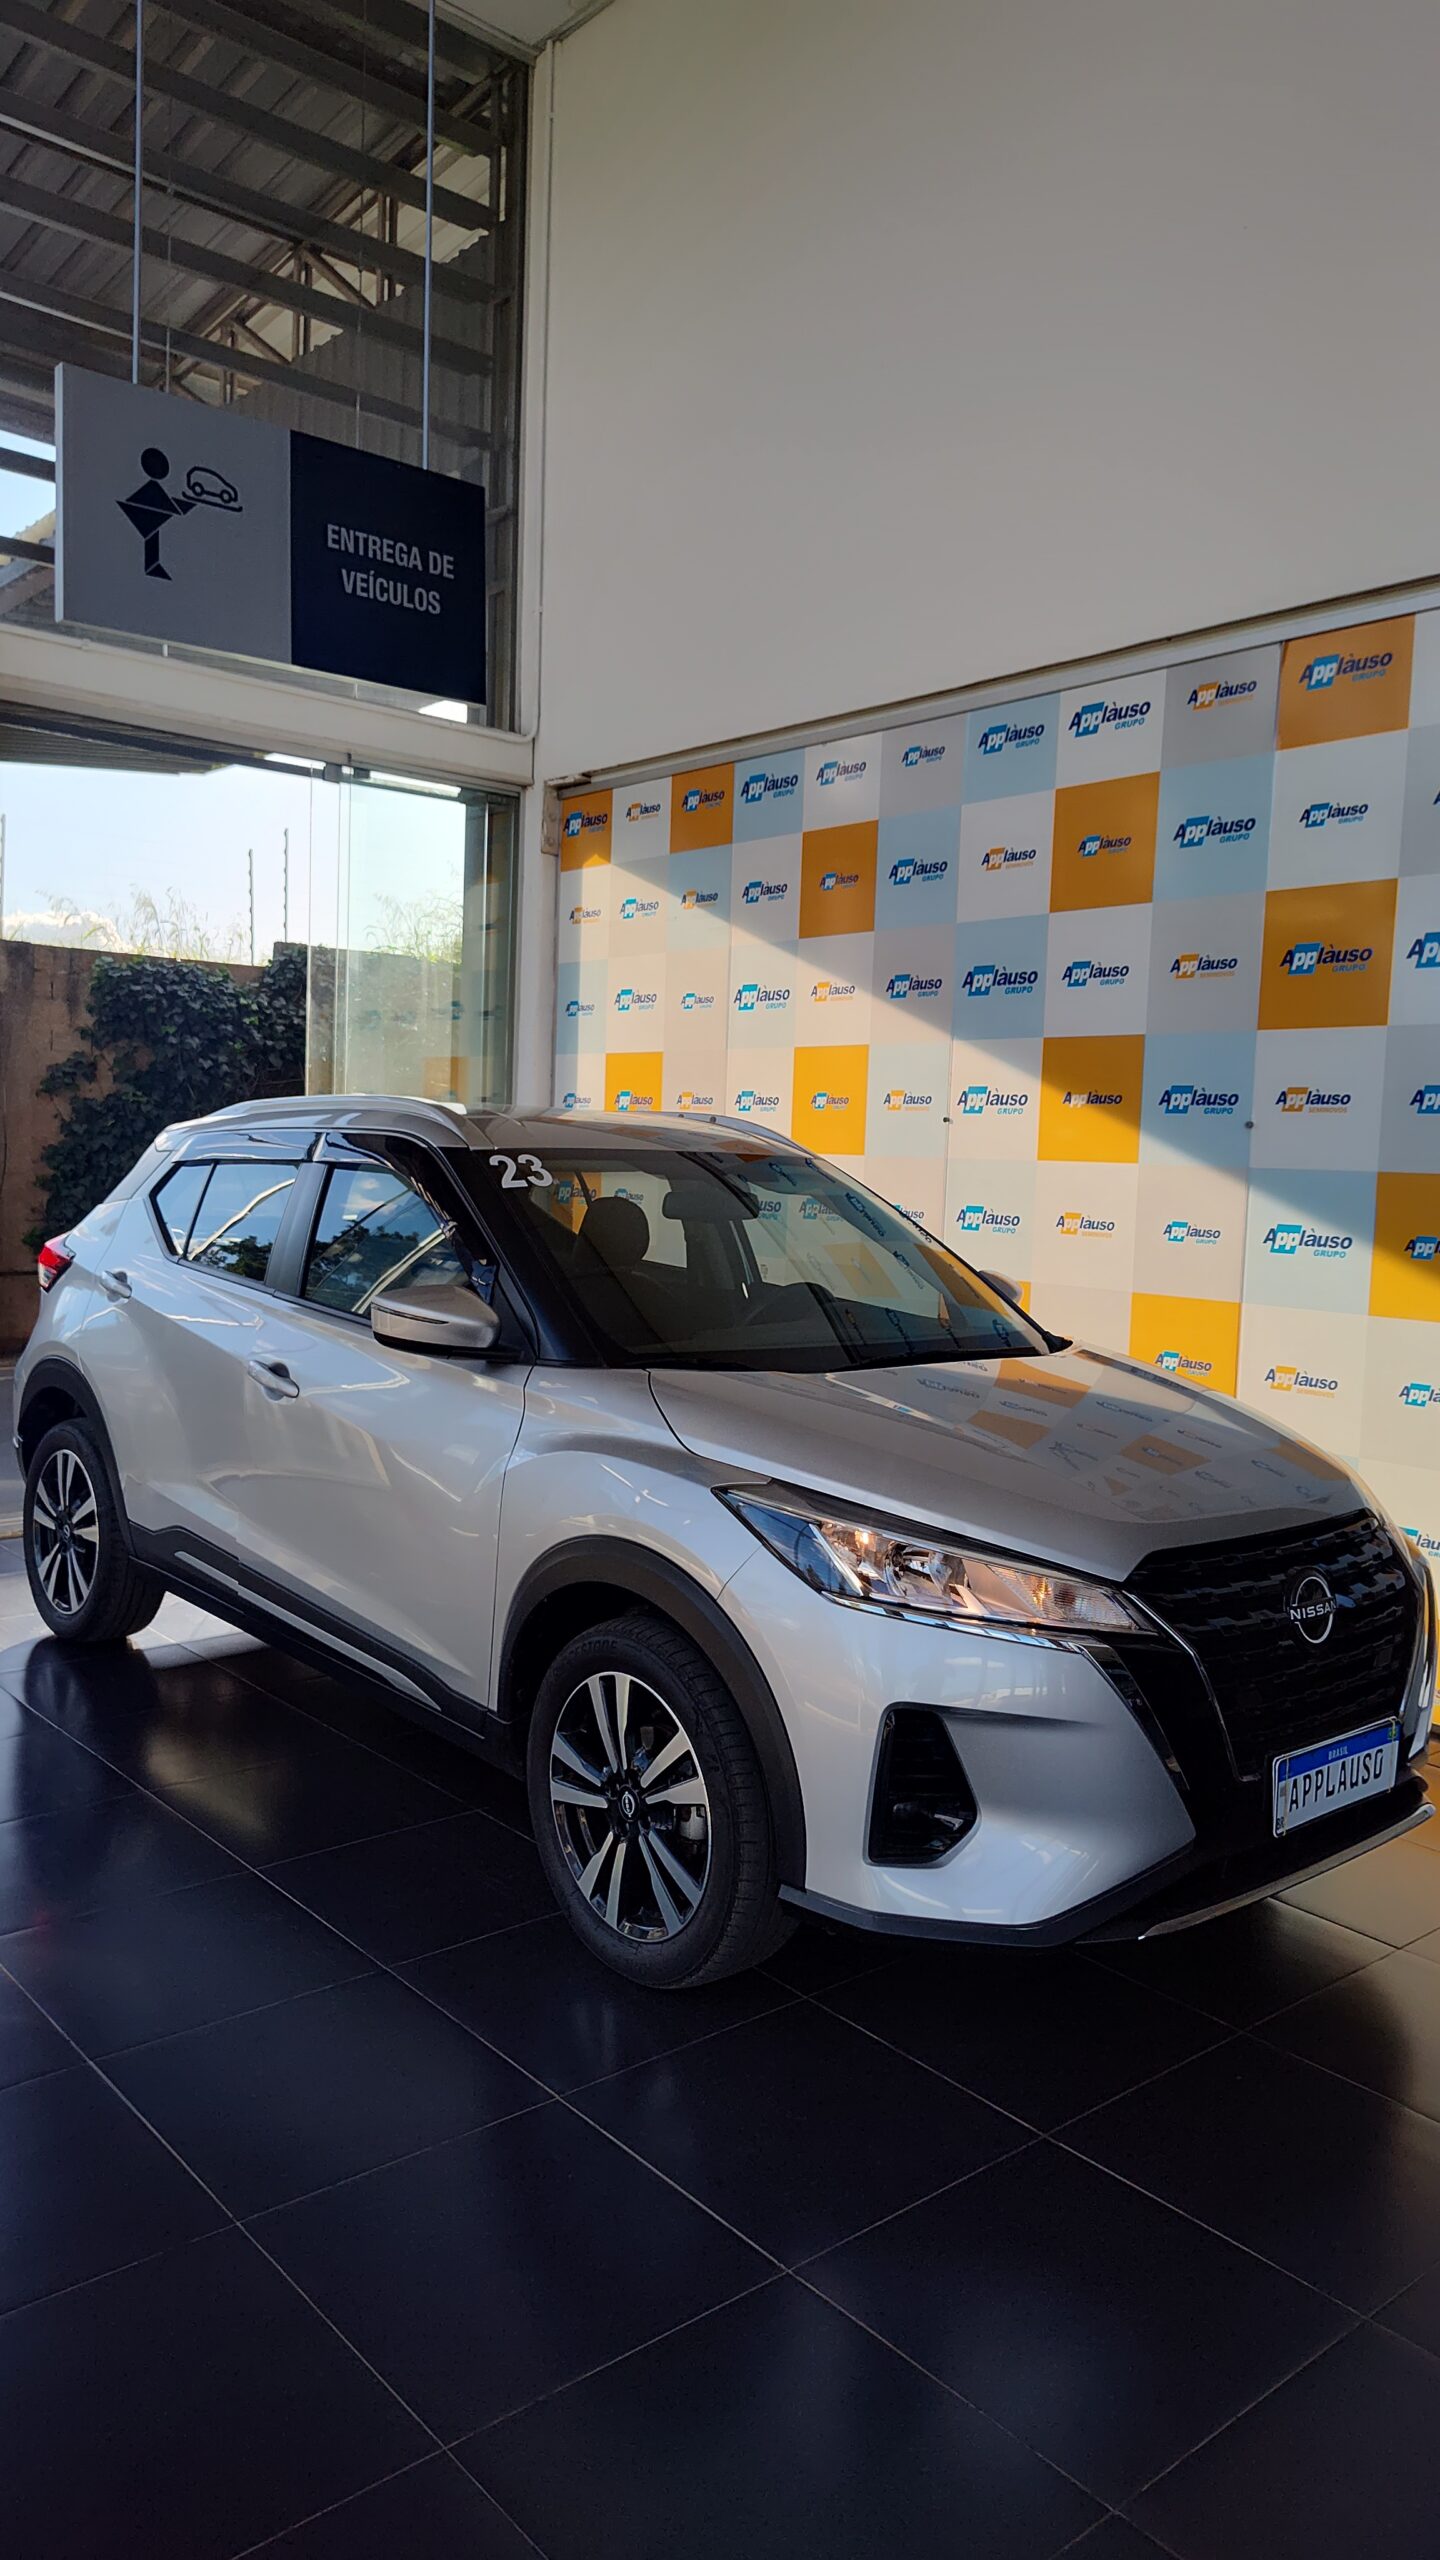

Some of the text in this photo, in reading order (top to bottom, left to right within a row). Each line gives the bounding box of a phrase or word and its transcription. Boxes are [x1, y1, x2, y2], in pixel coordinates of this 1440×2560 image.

[327, 523, 455, 580] ENTREGA DE
[341, 568, 441, 615] VEÍCULOS
[1352, 669, 1386, 682] GRUPO
[1114, 717, 1145, 730] GRUPO
[1015, 738, 1040, 749] GRUPO
[773, 788, 795, 798] GRUPO
[1337, 815, 1364, 824] GRUPO
[1219, 832, 1250, 844] GRUPO
[921, 874, 944, 882] GRUPO
[1332, 963, 1366, 973] GRUPO
[1099, 978, 1125, 986] GRUPO
[917, 990, 938, 998] GRUPO
[1004, 985, 1033, 994] GRUPO
[765, 1002, 787, 1010] GRUPO
[997, 1107, 1024, 1115] GRUPO
[1203, 1107, 1234, 1115] GRUPO
[489, 1154, 553, 1188] 23
[992, 1226, 1016, 1234] GRUPO
[1313, 1249, 1346, 1258] GRUPO
[1290, 1600, 1337, 1620] NISSAN
[1328, 1745, 1348, 1760] BRASIL
[1289, 1748, 1384, 1813] APPLAUSO
